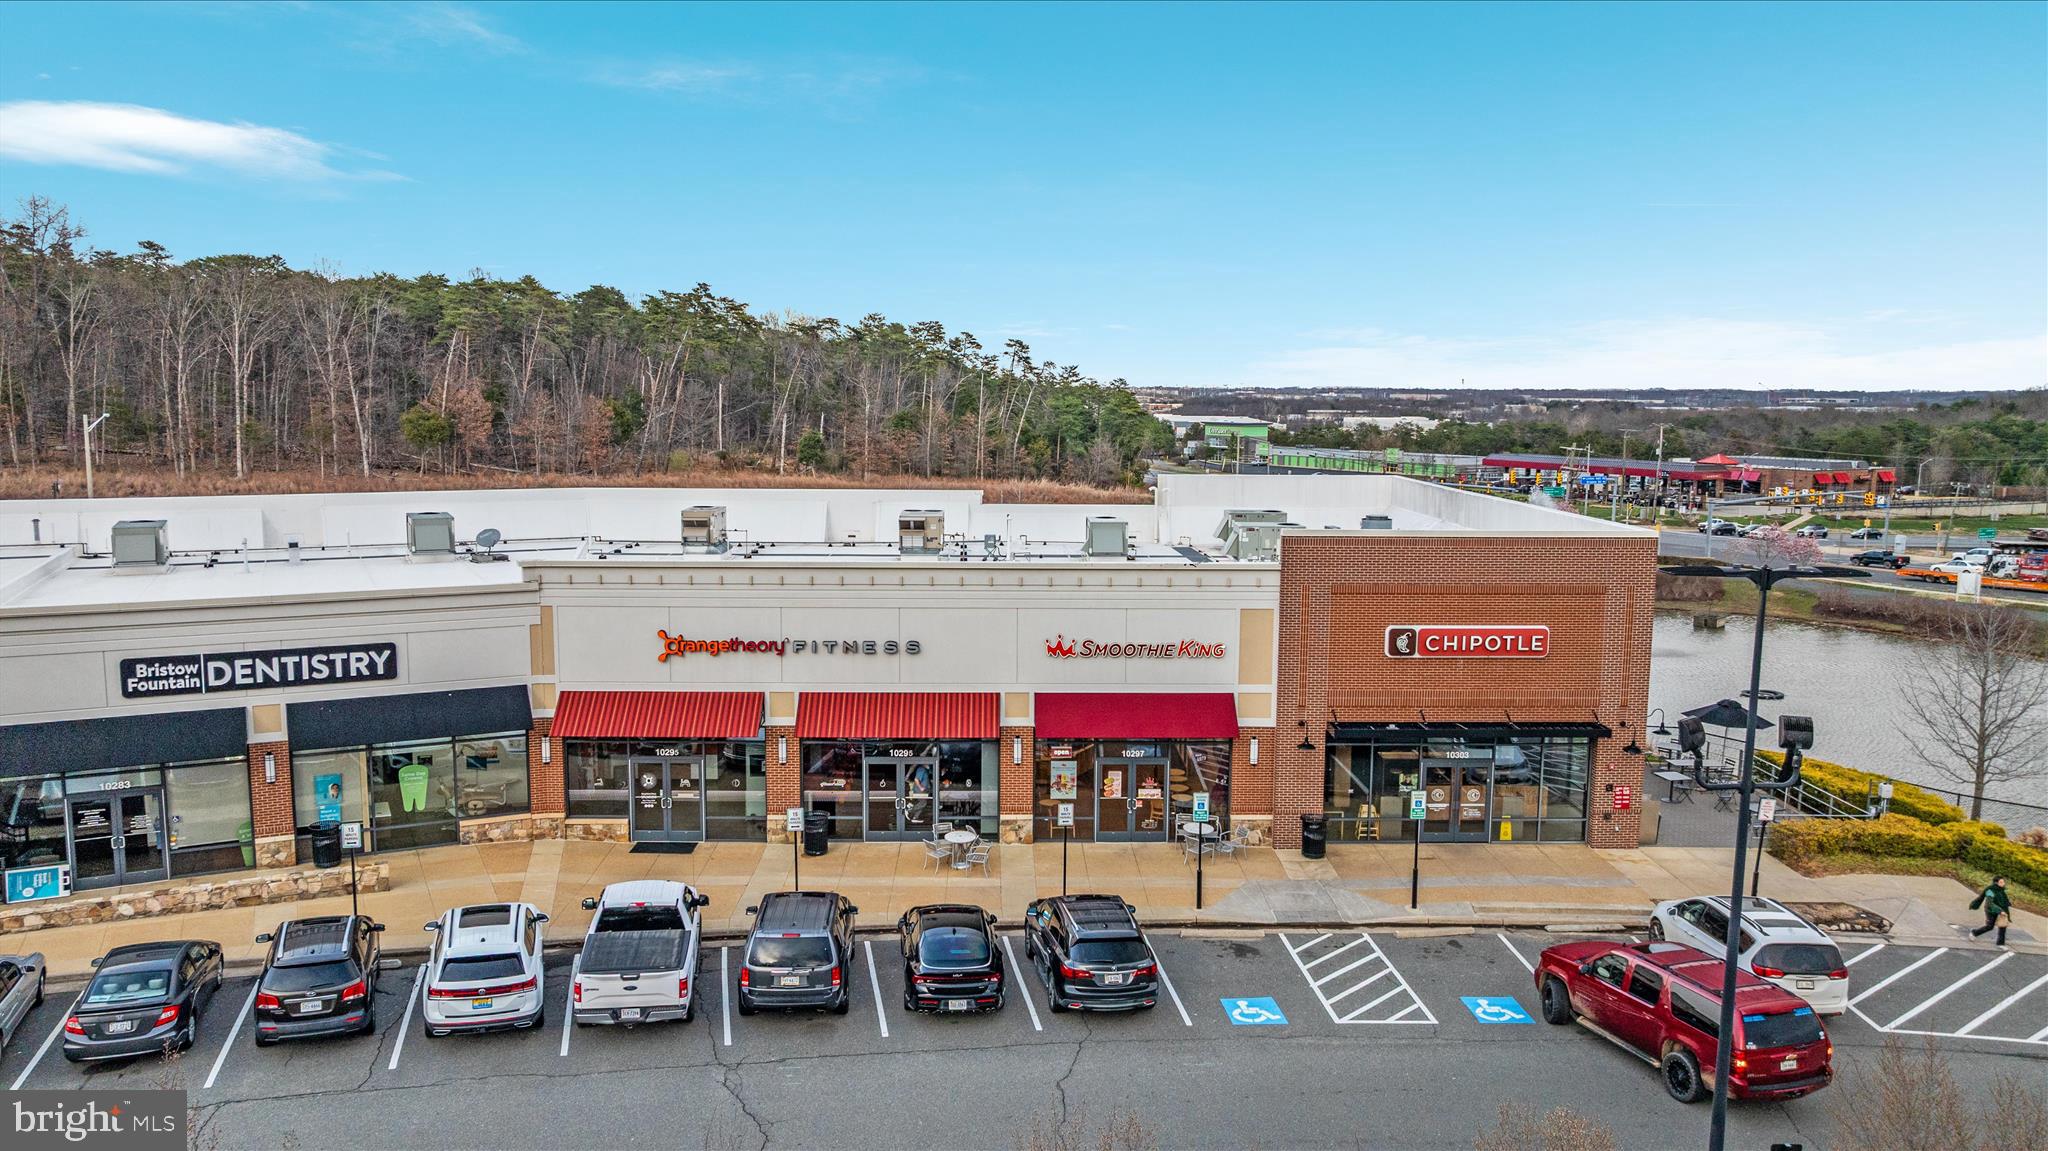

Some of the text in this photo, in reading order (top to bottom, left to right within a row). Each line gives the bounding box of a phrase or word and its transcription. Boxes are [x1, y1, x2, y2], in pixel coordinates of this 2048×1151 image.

[792, 640, 921, 654] FITNESS
[1079, 640, 1177, 658] SMOOTHIE
[1425, 635, 1544, 652] CHIPOTLE
[135, 662, 199, 678] Bristow
[207, 650, 392, 687] DENTISTRY
[127, 675, 201, 692] Fountain
[889, 749, 914, 757] 10295
[1446, 751, 1469, 759] 10303
[99, 781, 131, 791] 10283
